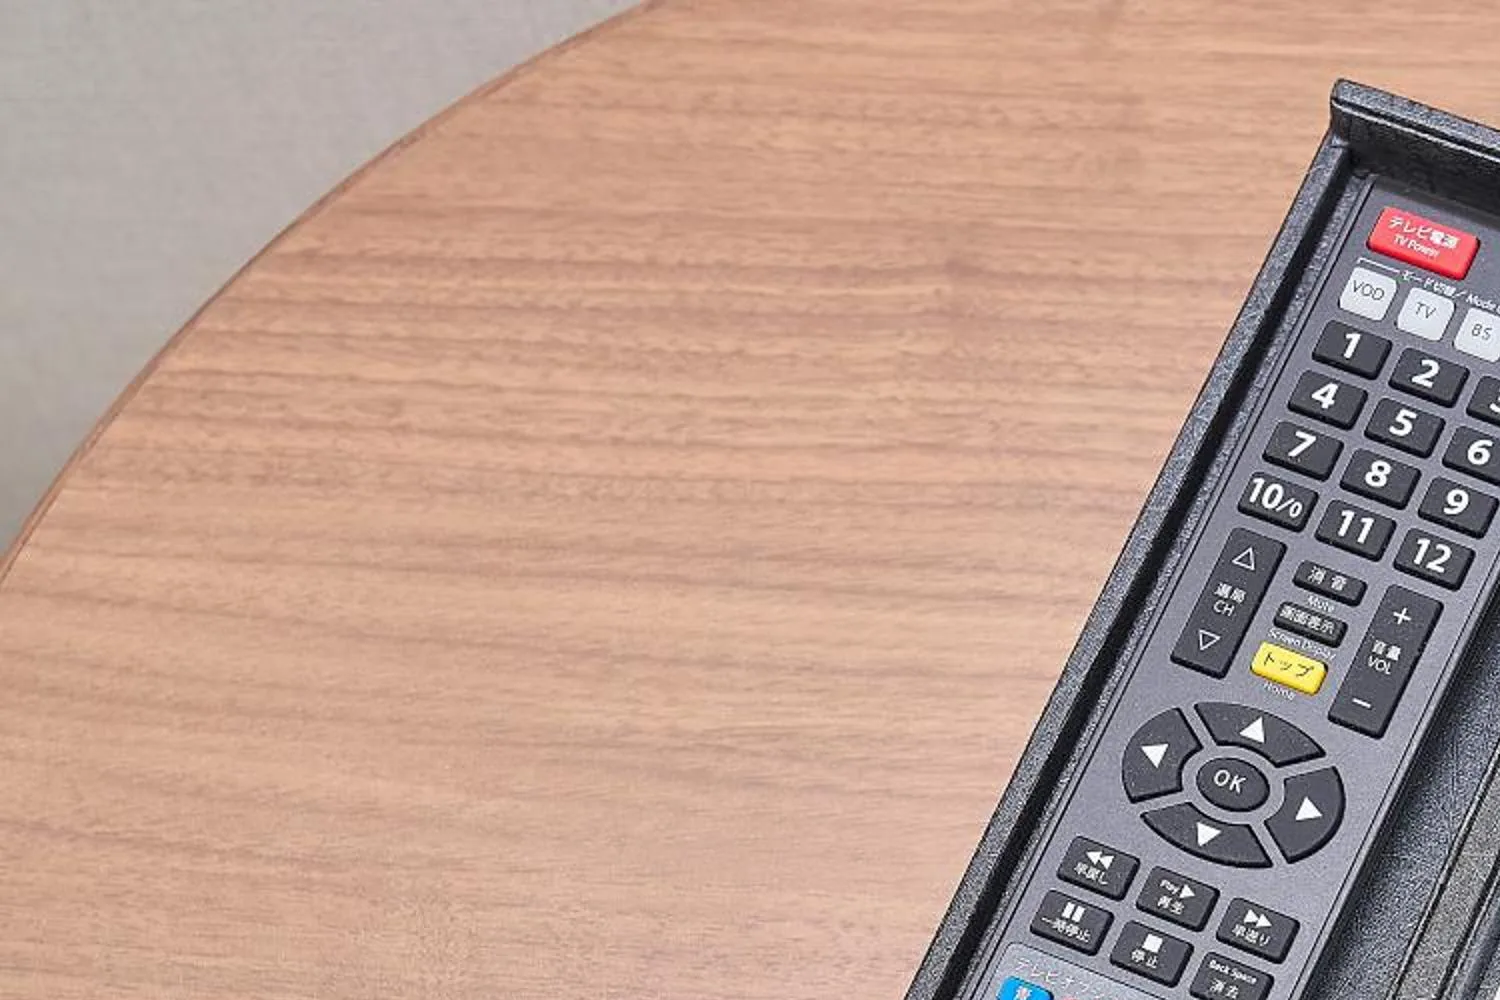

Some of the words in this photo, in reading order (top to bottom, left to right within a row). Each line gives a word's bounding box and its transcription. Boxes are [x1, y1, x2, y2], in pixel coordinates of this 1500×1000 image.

[1388, 217, 1459, 249] テレビ電源
[1393, 235, 1408, 248] TV
[1408, 239, 1440, 257] Power
[1352, 280, 1385, 301] VOD
[1467, 294, 1496, 312] Mode
[1415, 302, 1436, 320] TV
[1471, 323, 1492, 340] BS
[1344, 332, 1361, 359] 1
[1411, 359, 1440, 388] 2
[1311, 382, 1339, 410] 4
[1388, 409, 1418, 437] 5
[1287, 431, 1317, 459] 7
[1466, 439, 1495, 466] 6
[1364, 460, 1392, 488] 8
[1249, 477, 1303, 519] 10/0
[1443, 489, 1469, 515] 9
[1337, 510, 1375, 545] 11
[1412, 538, 1451, 574] 12
[1307, 568, 1348, 592] 消音
[1213, 601, 1235, 617] CH
[1263, 652, 1315, 678] トップ
[1367, 656, 1393, 675] VOL
[1213, 769, 1247, 794] OK
[1130, 949, 1159, 969] 停止
[1209, 959, 1231, 976] Back
